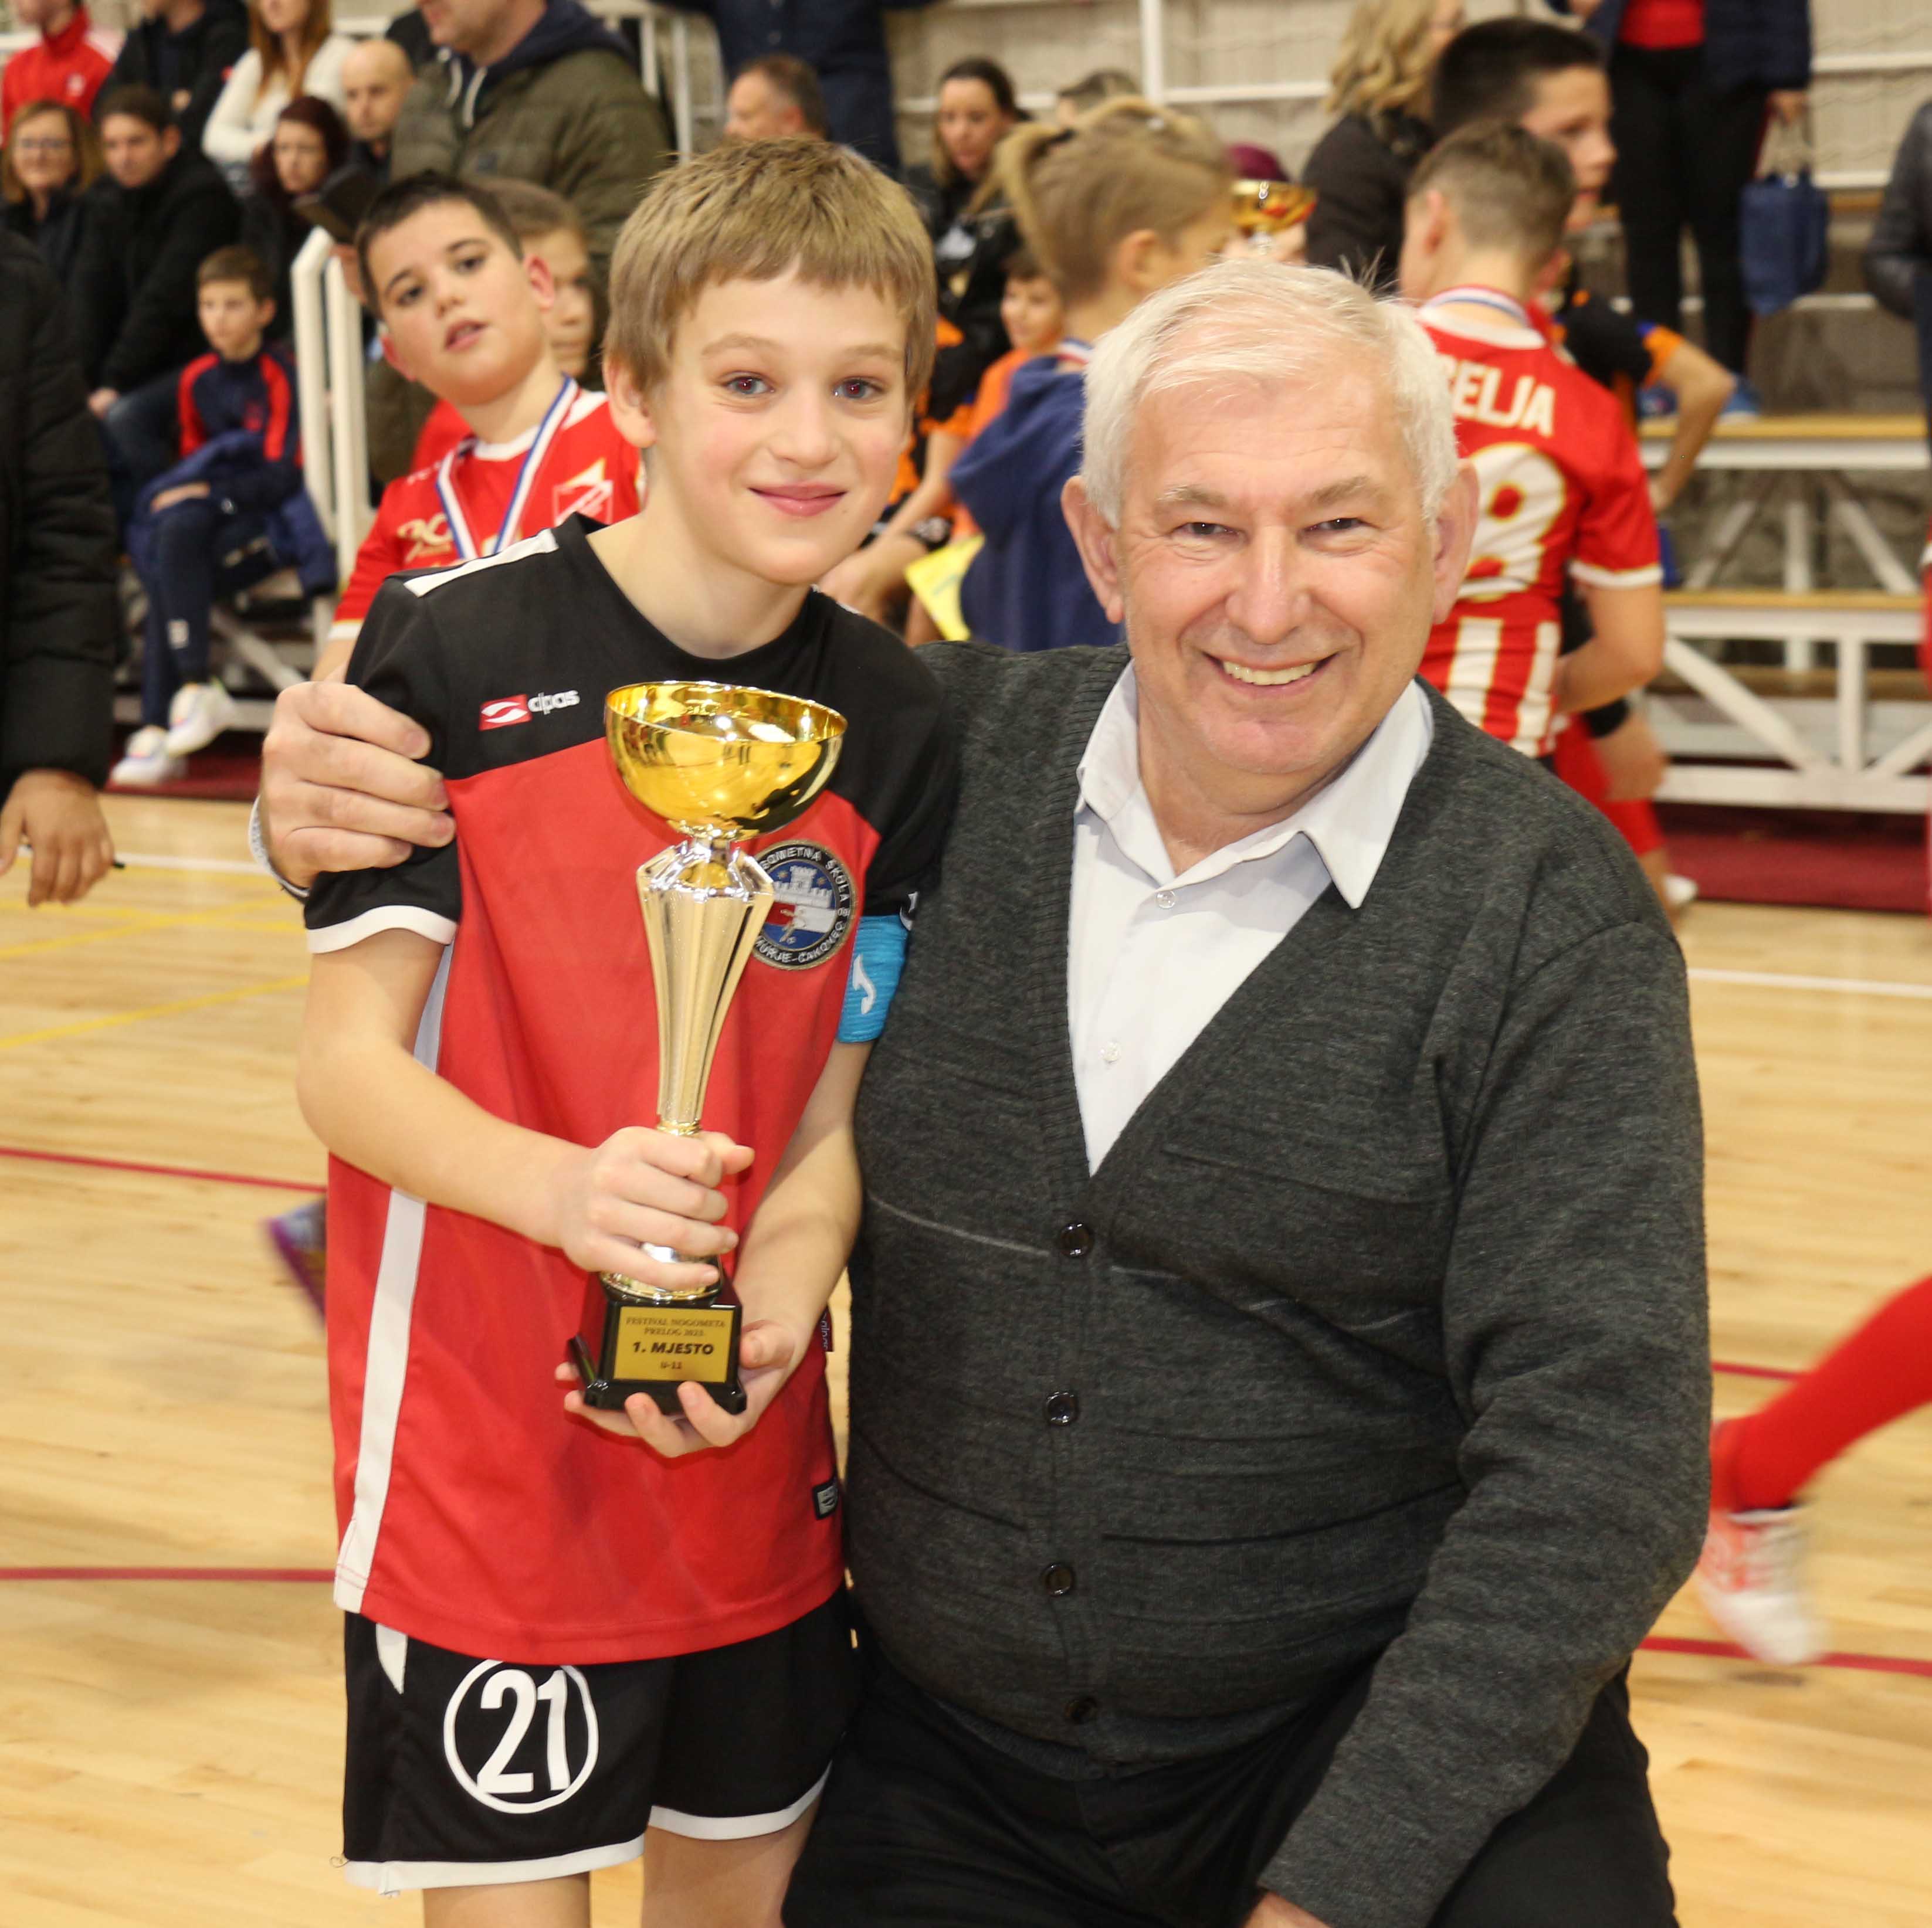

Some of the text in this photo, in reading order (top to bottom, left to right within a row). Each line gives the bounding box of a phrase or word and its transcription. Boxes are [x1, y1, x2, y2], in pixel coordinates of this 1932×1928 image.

[1442, 354, 1555, 437] ELJA
[759, 847, 822, 870] GOMETNA
[633, 1342, 714, 1355] 1. MJESTO
[477, 1669, 571, 1794] 21
